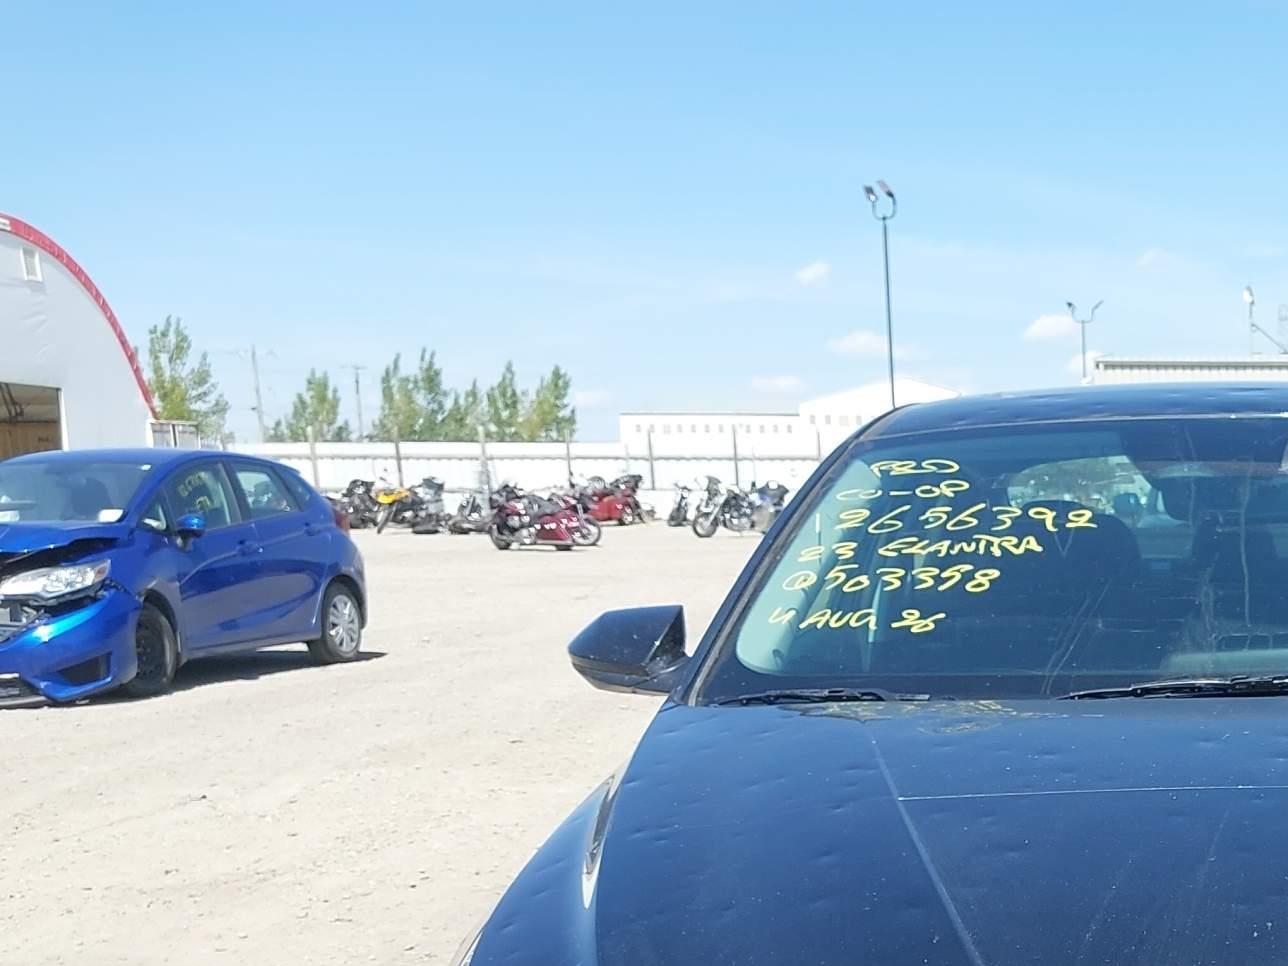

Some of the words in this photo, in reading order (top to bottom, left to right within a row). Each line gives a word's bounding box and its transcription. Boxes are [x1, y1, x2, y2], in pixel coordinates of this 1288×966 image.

[797, 541, 858, 562] 23
[878, 534, 1043, 558] ELANTRA
[799, 608, 879, 630] AUG
